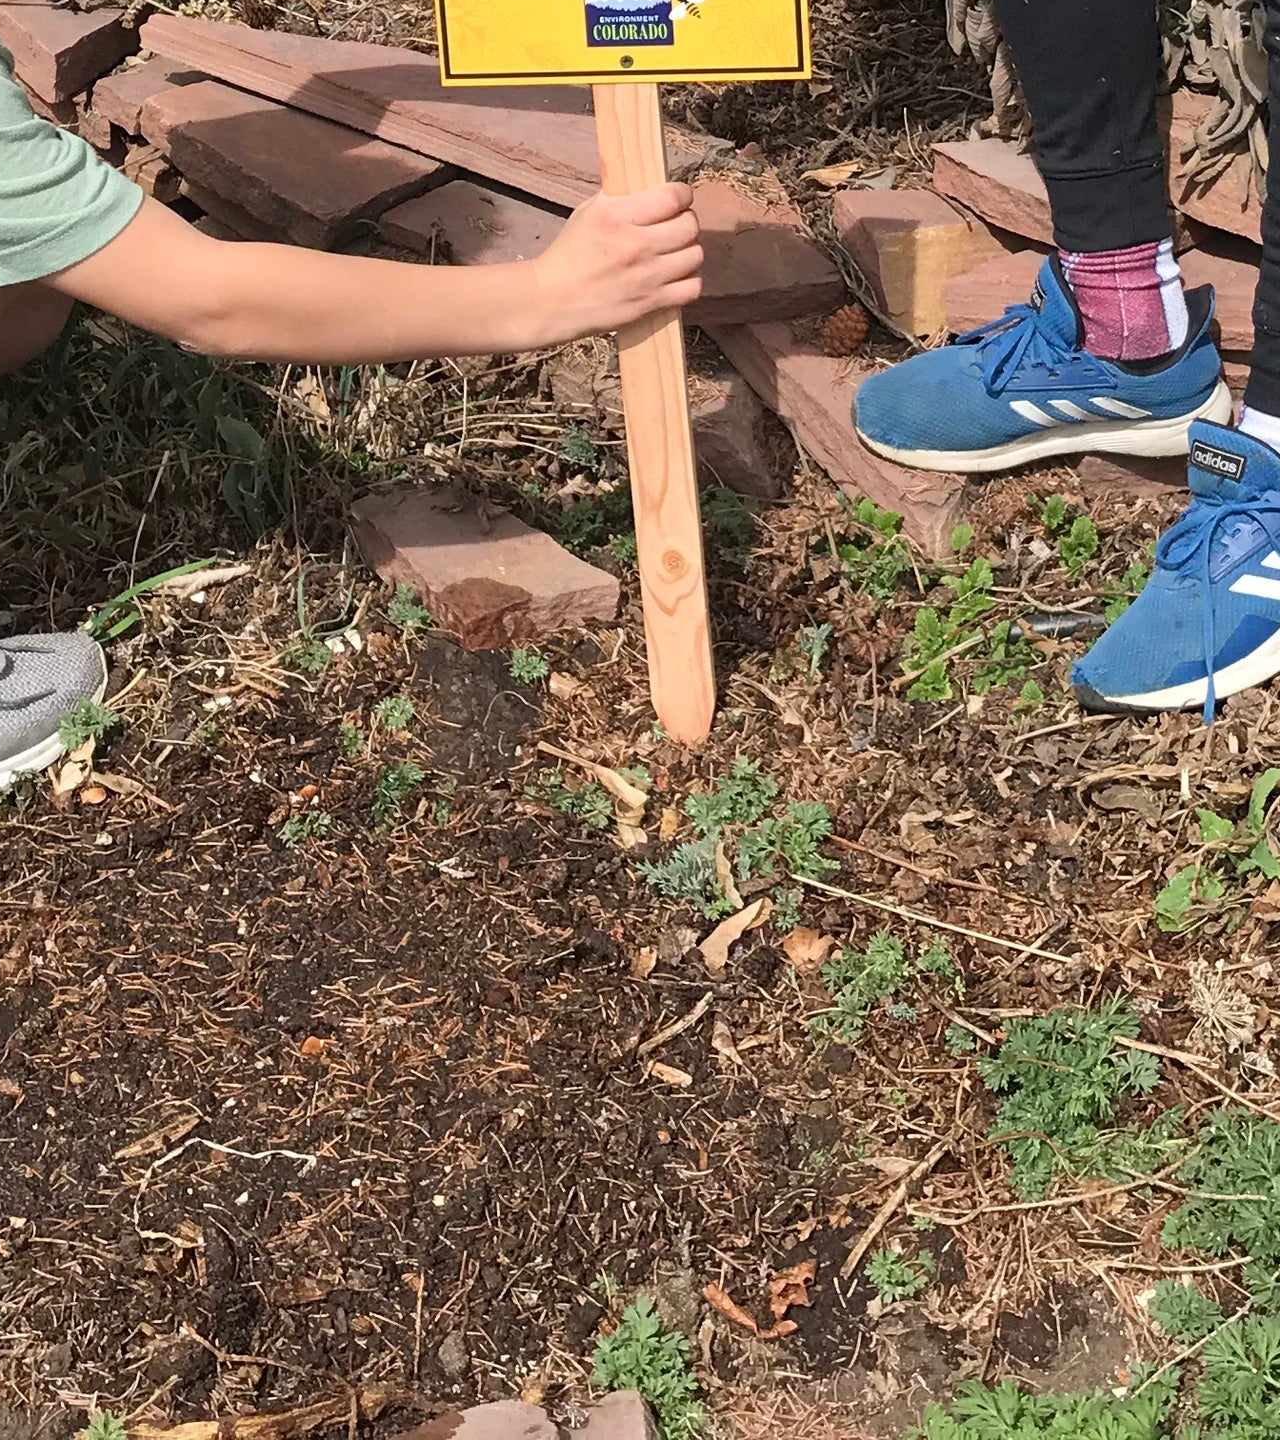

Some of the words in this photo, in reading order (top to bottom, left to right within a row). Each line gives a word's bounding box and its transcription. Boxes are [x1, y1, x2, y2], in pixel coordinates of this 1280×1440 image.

[599, 15, 660, 24] ENVIRONMENT
[593, 23, 668, 41] COLORADO
[1194, 451, 1237, 473] adidas
